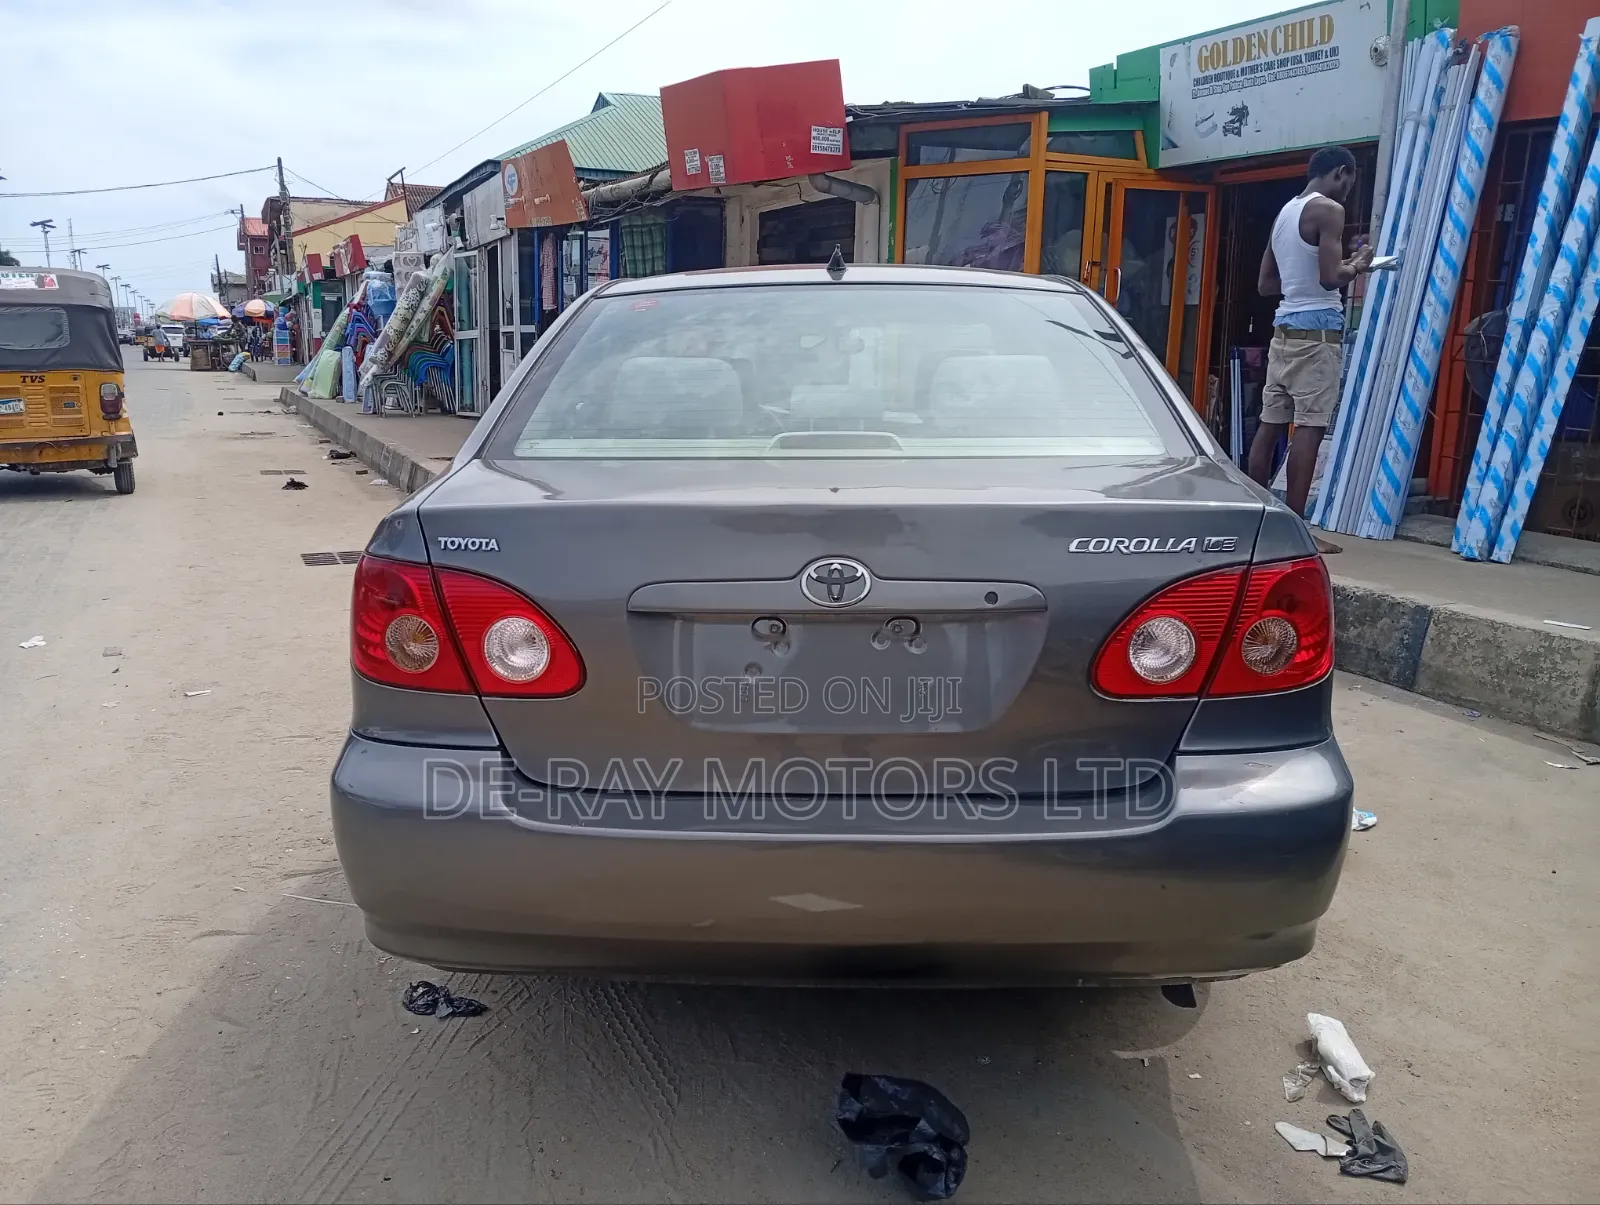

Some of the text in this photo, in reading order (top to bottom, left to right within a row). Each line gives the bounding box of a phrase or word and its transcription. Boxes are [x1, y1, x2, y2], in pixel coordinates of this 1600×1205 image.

[1197, 13, 1335, 73] GOLDEN CHILD
[1193, 74, 1213, 87] CHILDREN
[1214, 69, 1235, 82] BOUTIQUE
[1264, 59, 1276, 72] CARE
[1276, 56, 1289, 68] SHOP
[1304, 49, 1323, 63] TURKEY
[20, 375, 45, 384] TVS
[437, 536, 500, 552] TOYOTA
[1068, 536, 1239, 555] COROLLA LE
